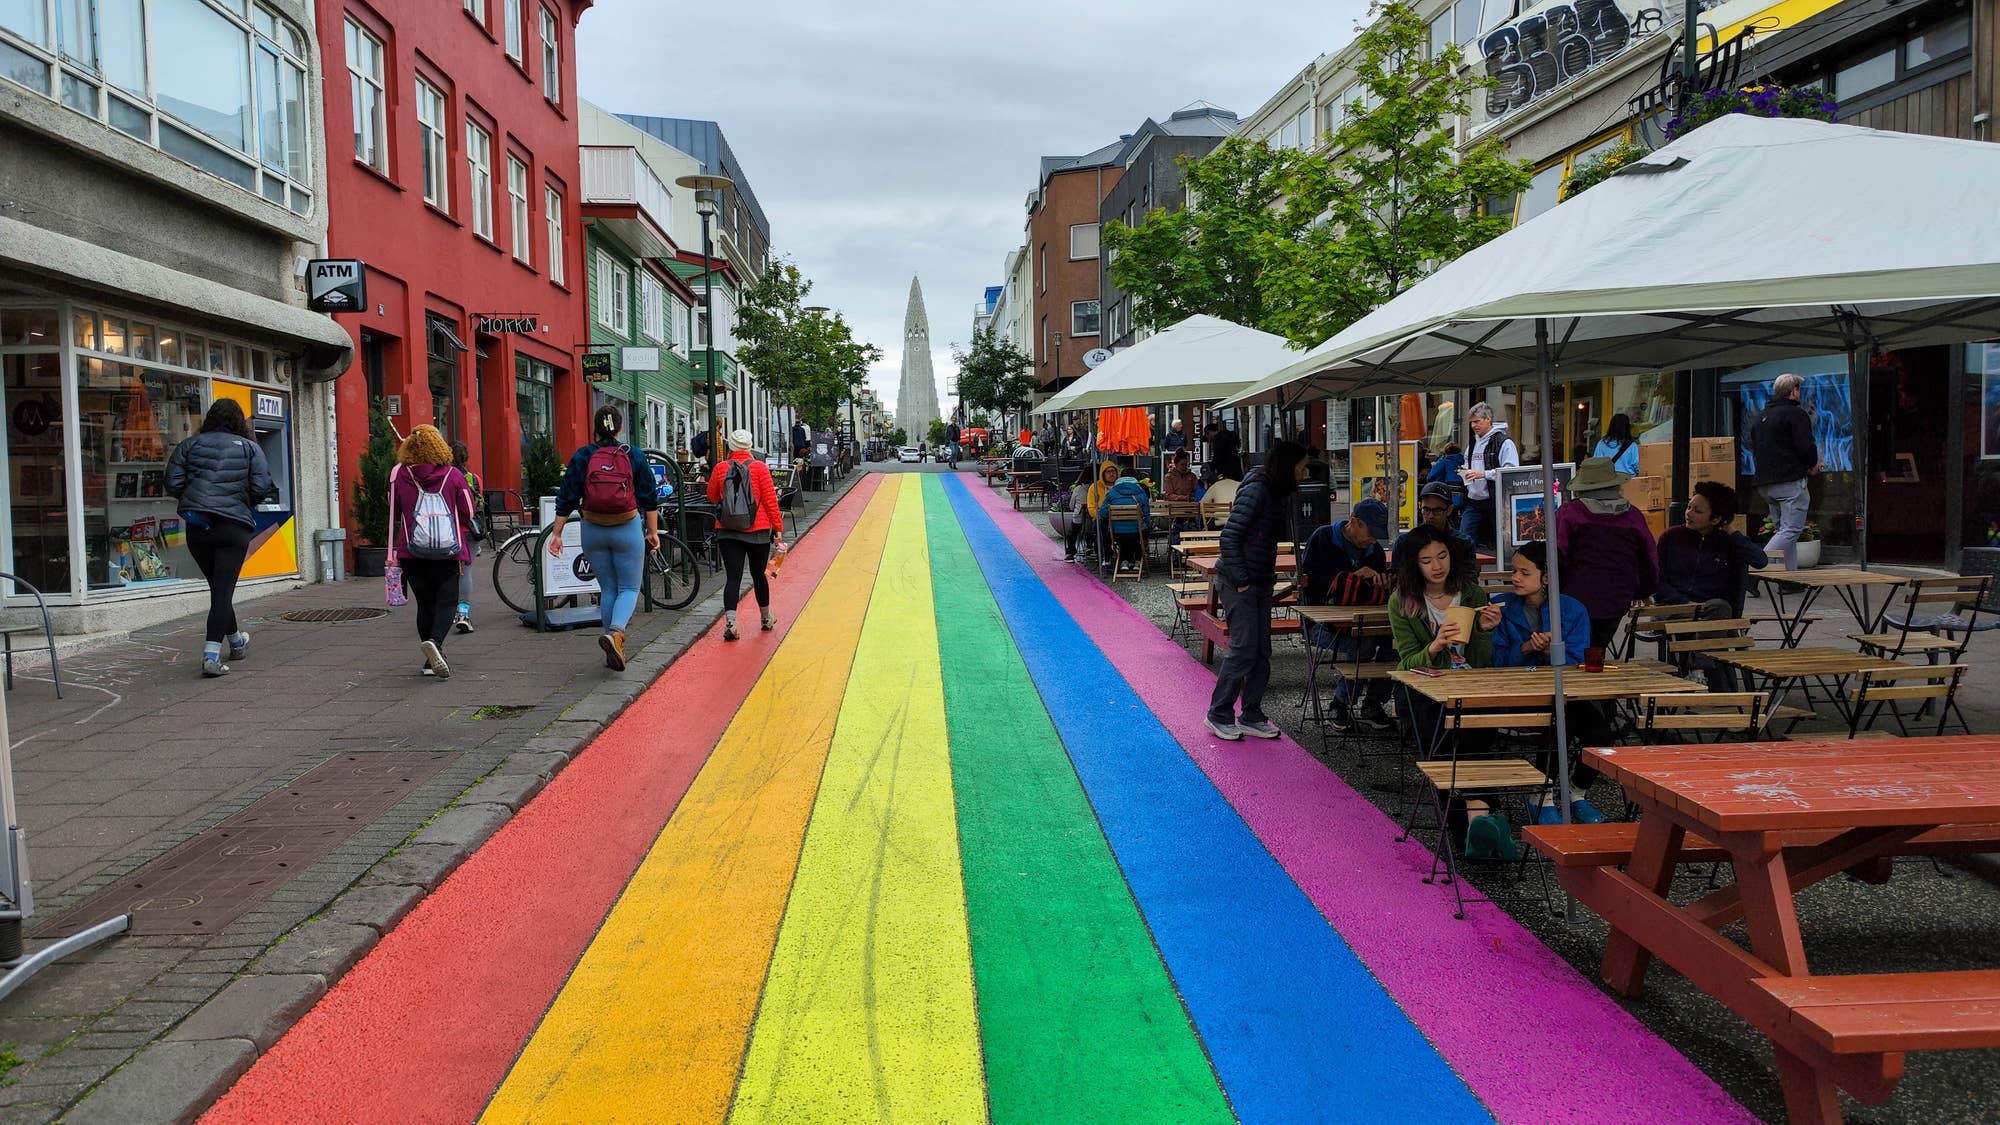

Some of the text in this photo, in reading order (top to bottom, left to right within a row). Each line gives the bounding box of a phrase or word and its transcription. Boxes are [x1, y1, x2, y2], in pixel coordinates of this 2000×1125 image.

[317, 264, 353, 278] ATM
[480, 317, 537, 335] MOKKA
[259, 398, 279, 415] ATM
[1534, 478, 1544, 487] fin
